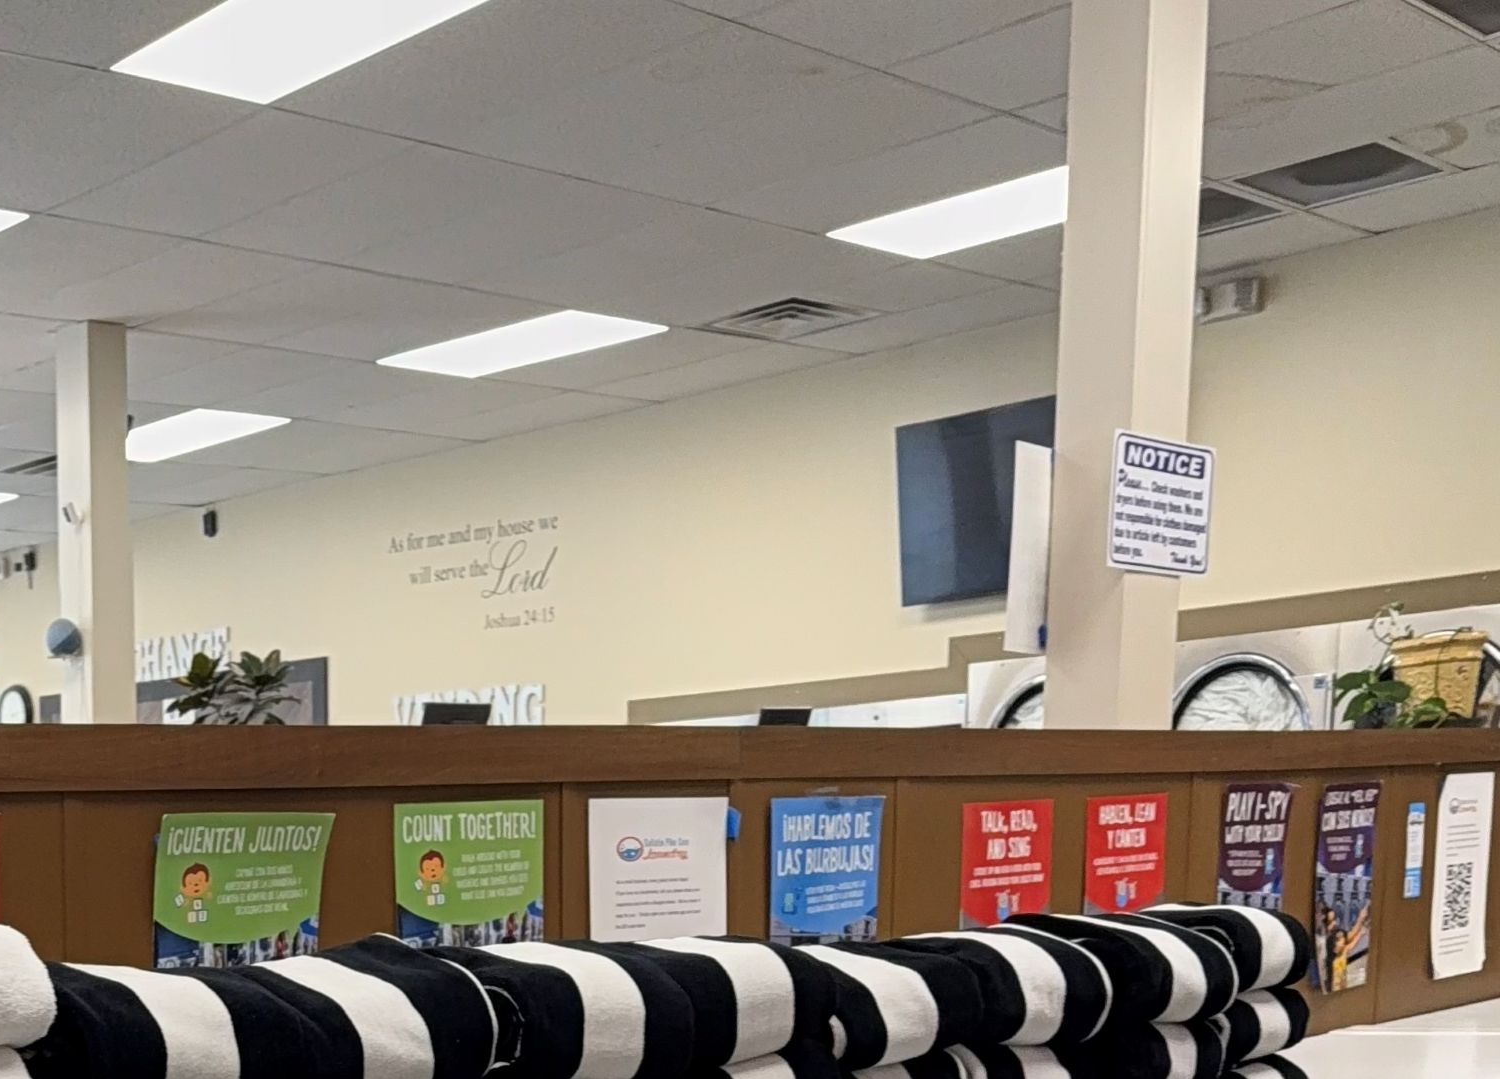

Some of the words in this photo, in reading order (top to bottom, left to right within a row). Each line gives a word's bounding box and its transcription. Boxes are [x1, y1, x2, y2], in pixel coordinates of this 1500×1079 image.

[1126, 445, 1203, 477] NOTICE
[389, 536, 404, 554] As
[406, 533, 424, 551] for
[426, 533, 446, 549] me
[448, 524, 471, 545] and
[474, 526, 494, 544] my
[497, 519, 535, 539] house
[538, 516, 558, 531] we
[409, 566, 432, 584] will
[434, 565, 466, 582] serve
[469, 559, 489, 577] the
[481, 539, 558, 599] Lord
[484, 612, 521, 630] Joshua
[1225, 791, 1257, 823] PLAY
[1254, 790, 1292, 821] I-SPY
[167, 825, 246, 856] ¡CUENTEN
[250, 825, 322, 853] JUNTOS!
[403, 814, 453, 844] COUNT
[458, 811, 536, 840] TOGETHER!
[854, 811, 873, 839] DE
[1106, 829, 1114, 850] Y
[777, 848, 804, 877] LAS
[804, 844, 874, 875] BURBUJAS!
[986, 838, 1006, 860] AND
[1008, 836, 1032, 859] SING
